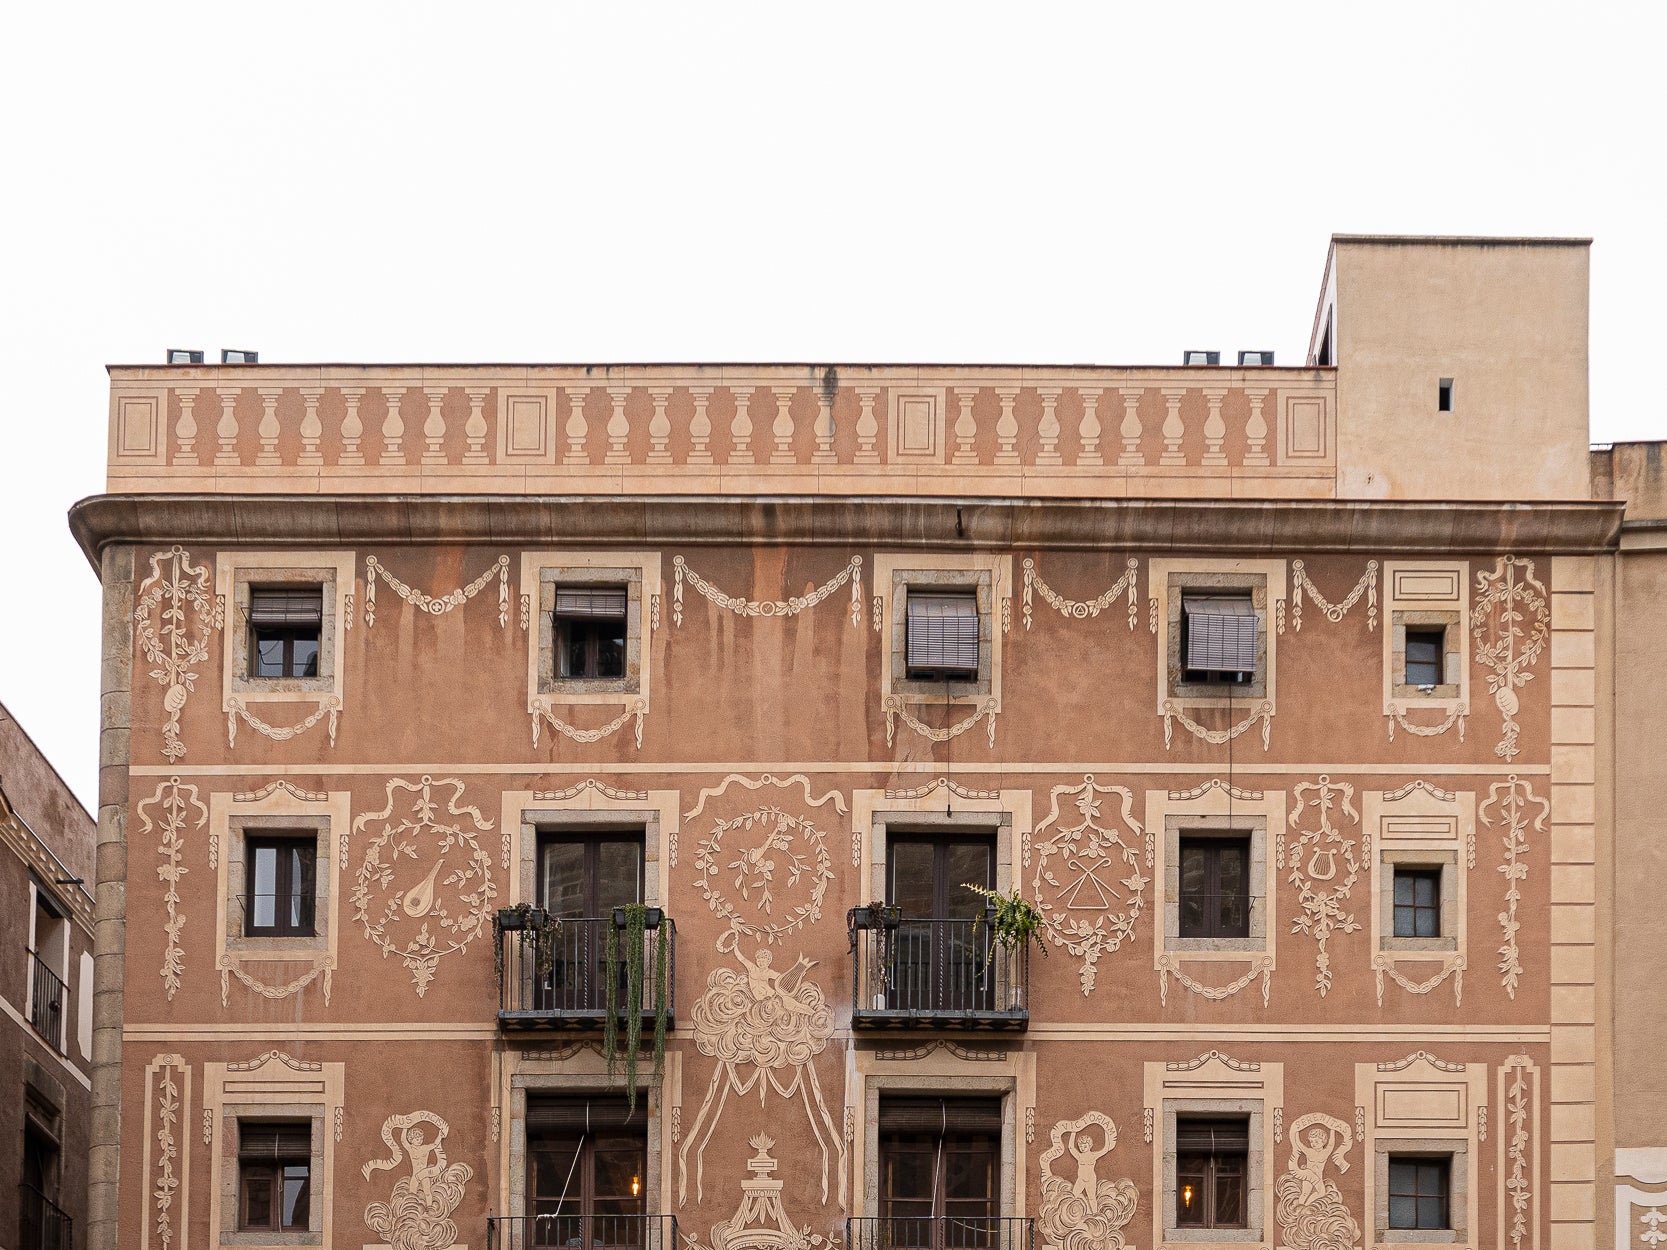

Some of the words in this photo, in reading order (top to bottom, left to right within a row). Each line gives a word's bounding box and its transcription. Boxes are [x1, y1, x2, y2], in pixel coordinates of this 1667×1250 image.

[419, 1111, 445, 1127] PACIS
[1062, 1113, 1116, 1136] VICTORIAM
[1295, 1112, 1349, 1134] SERENITAS
